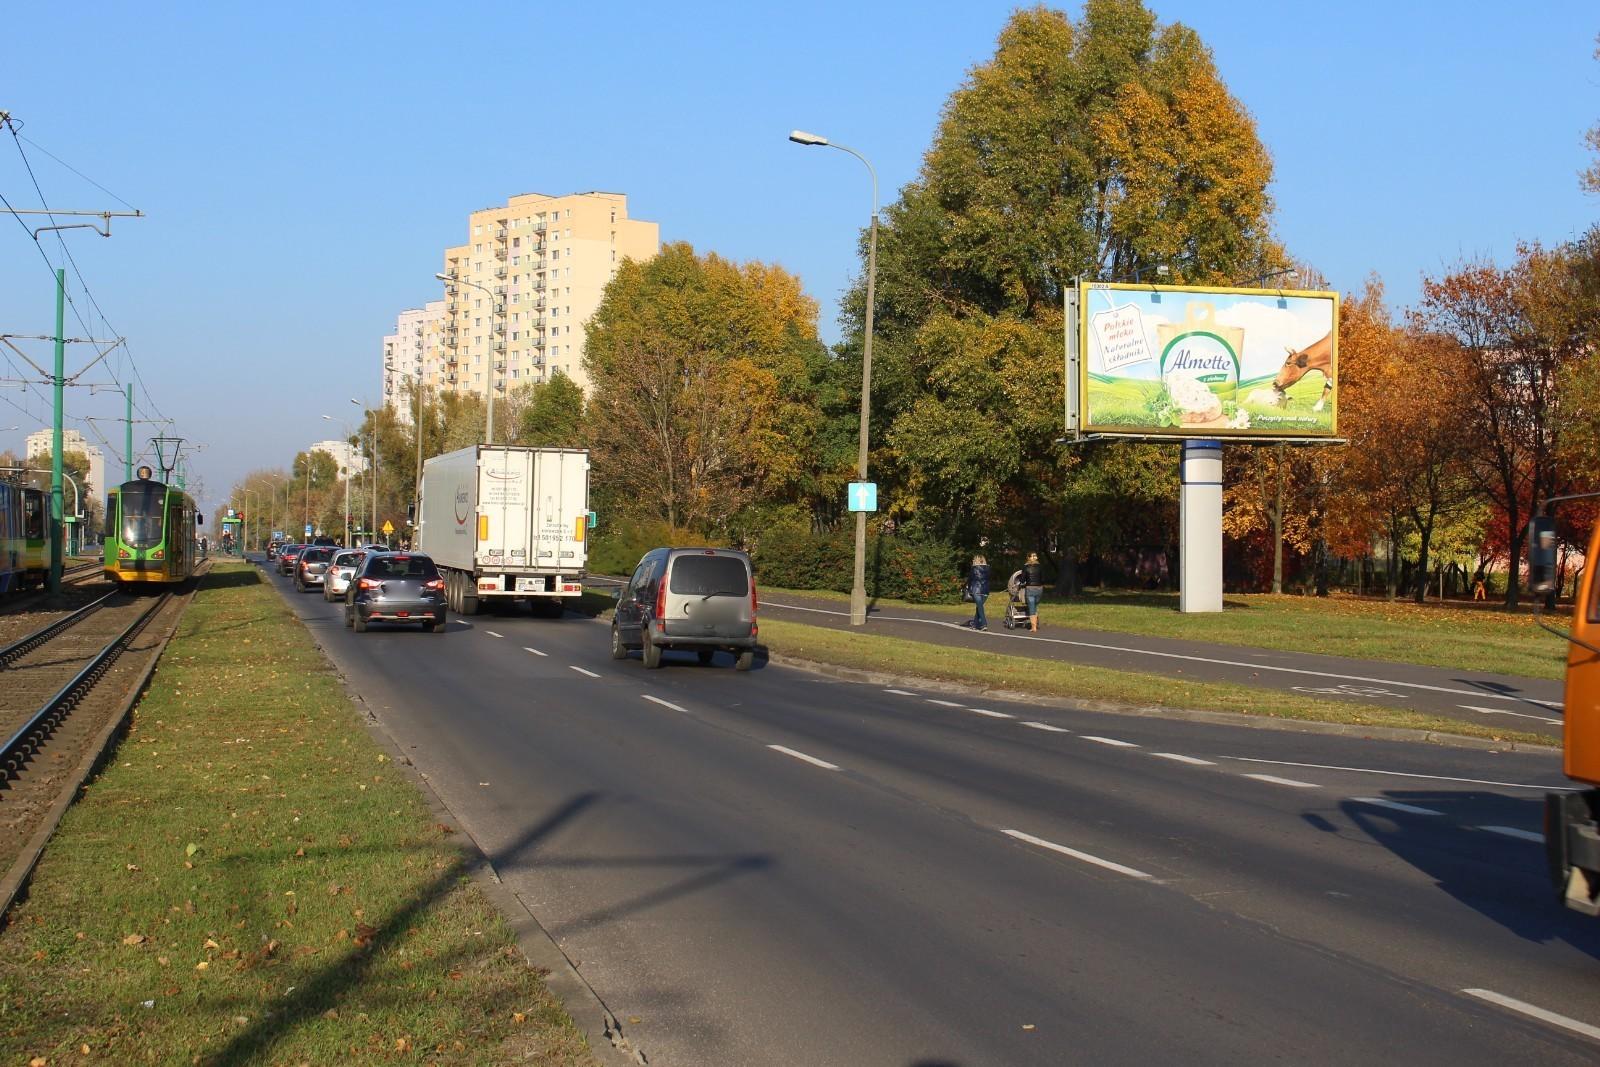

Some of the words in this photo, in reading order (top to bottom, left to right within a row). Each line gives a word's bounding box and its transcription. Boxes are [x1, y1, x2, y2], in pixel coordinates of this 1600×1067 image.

[1103, 317, 1134, 332] Polskie
[1109, 329, 1134, 341] mleko
[1103, 338, 1144, 355] Naturalne
[1108, 347, 1144, 363] składniki
[1165, 349, 1231, 373] Almette
